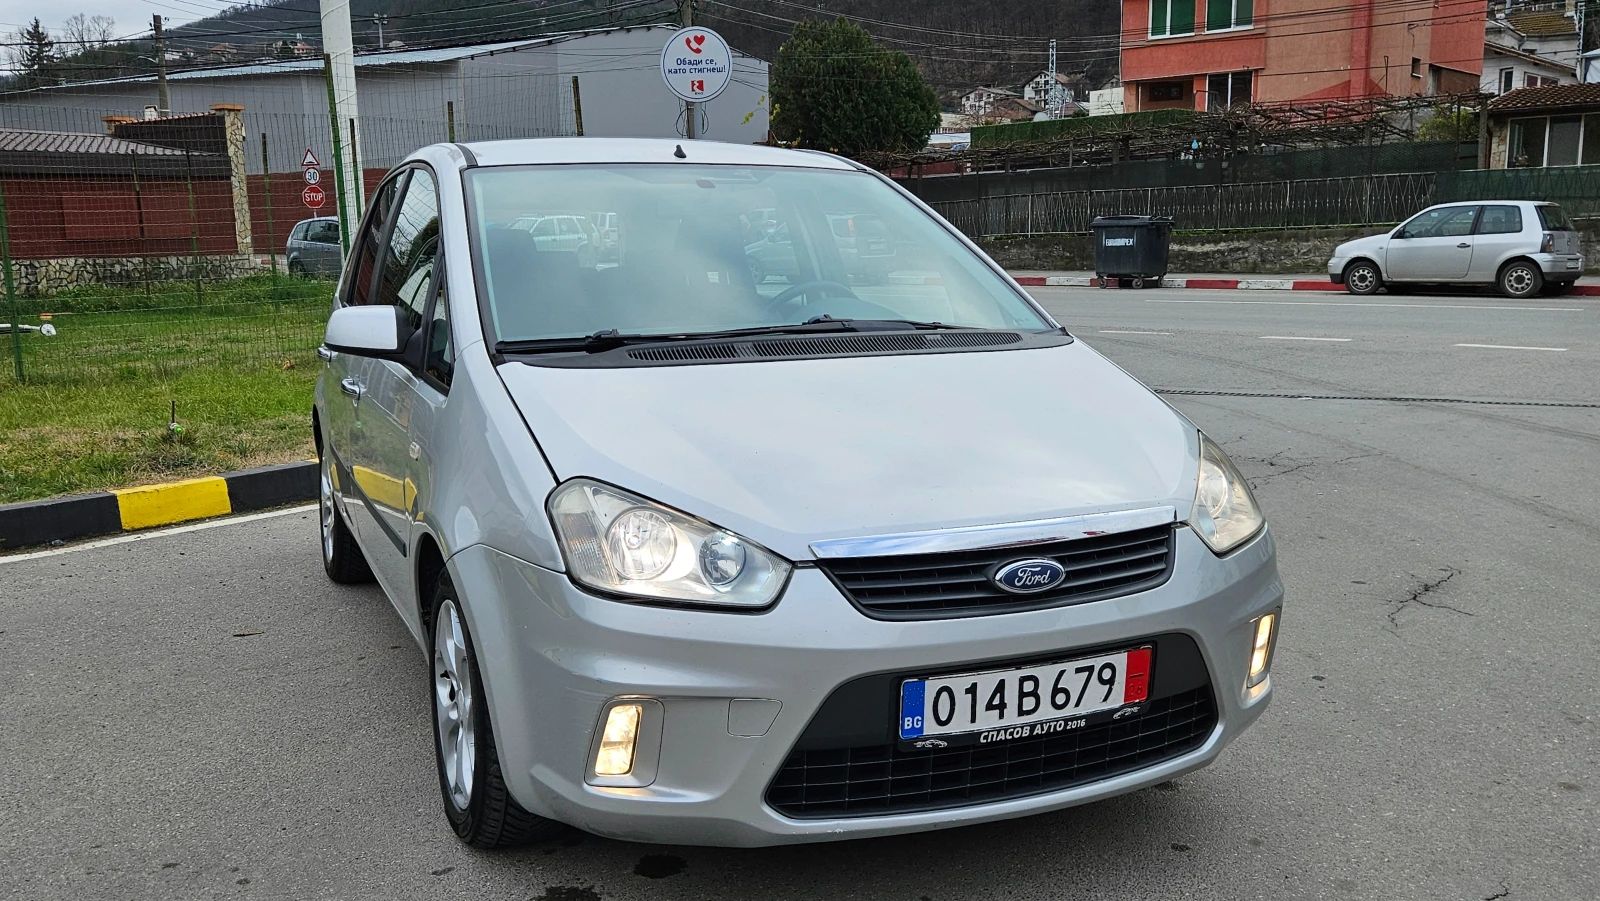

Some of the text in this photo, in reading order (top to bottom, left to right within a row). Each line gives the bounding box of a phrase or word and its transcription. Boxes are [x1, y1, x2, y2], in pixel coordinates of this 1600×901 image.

[676, 57, 717, 67] Обади се,
[668, 65, 726, 75] като стигнеш!
[307, 171, 318, 181] 30
[305, 193, 323, 202] STOP
[1014, 566, 1051, 587] Ford
[904, 661, 1117, 730] BG 014B679
[979, 719, 1086, 743] СПАСОВ АУТО 2016
